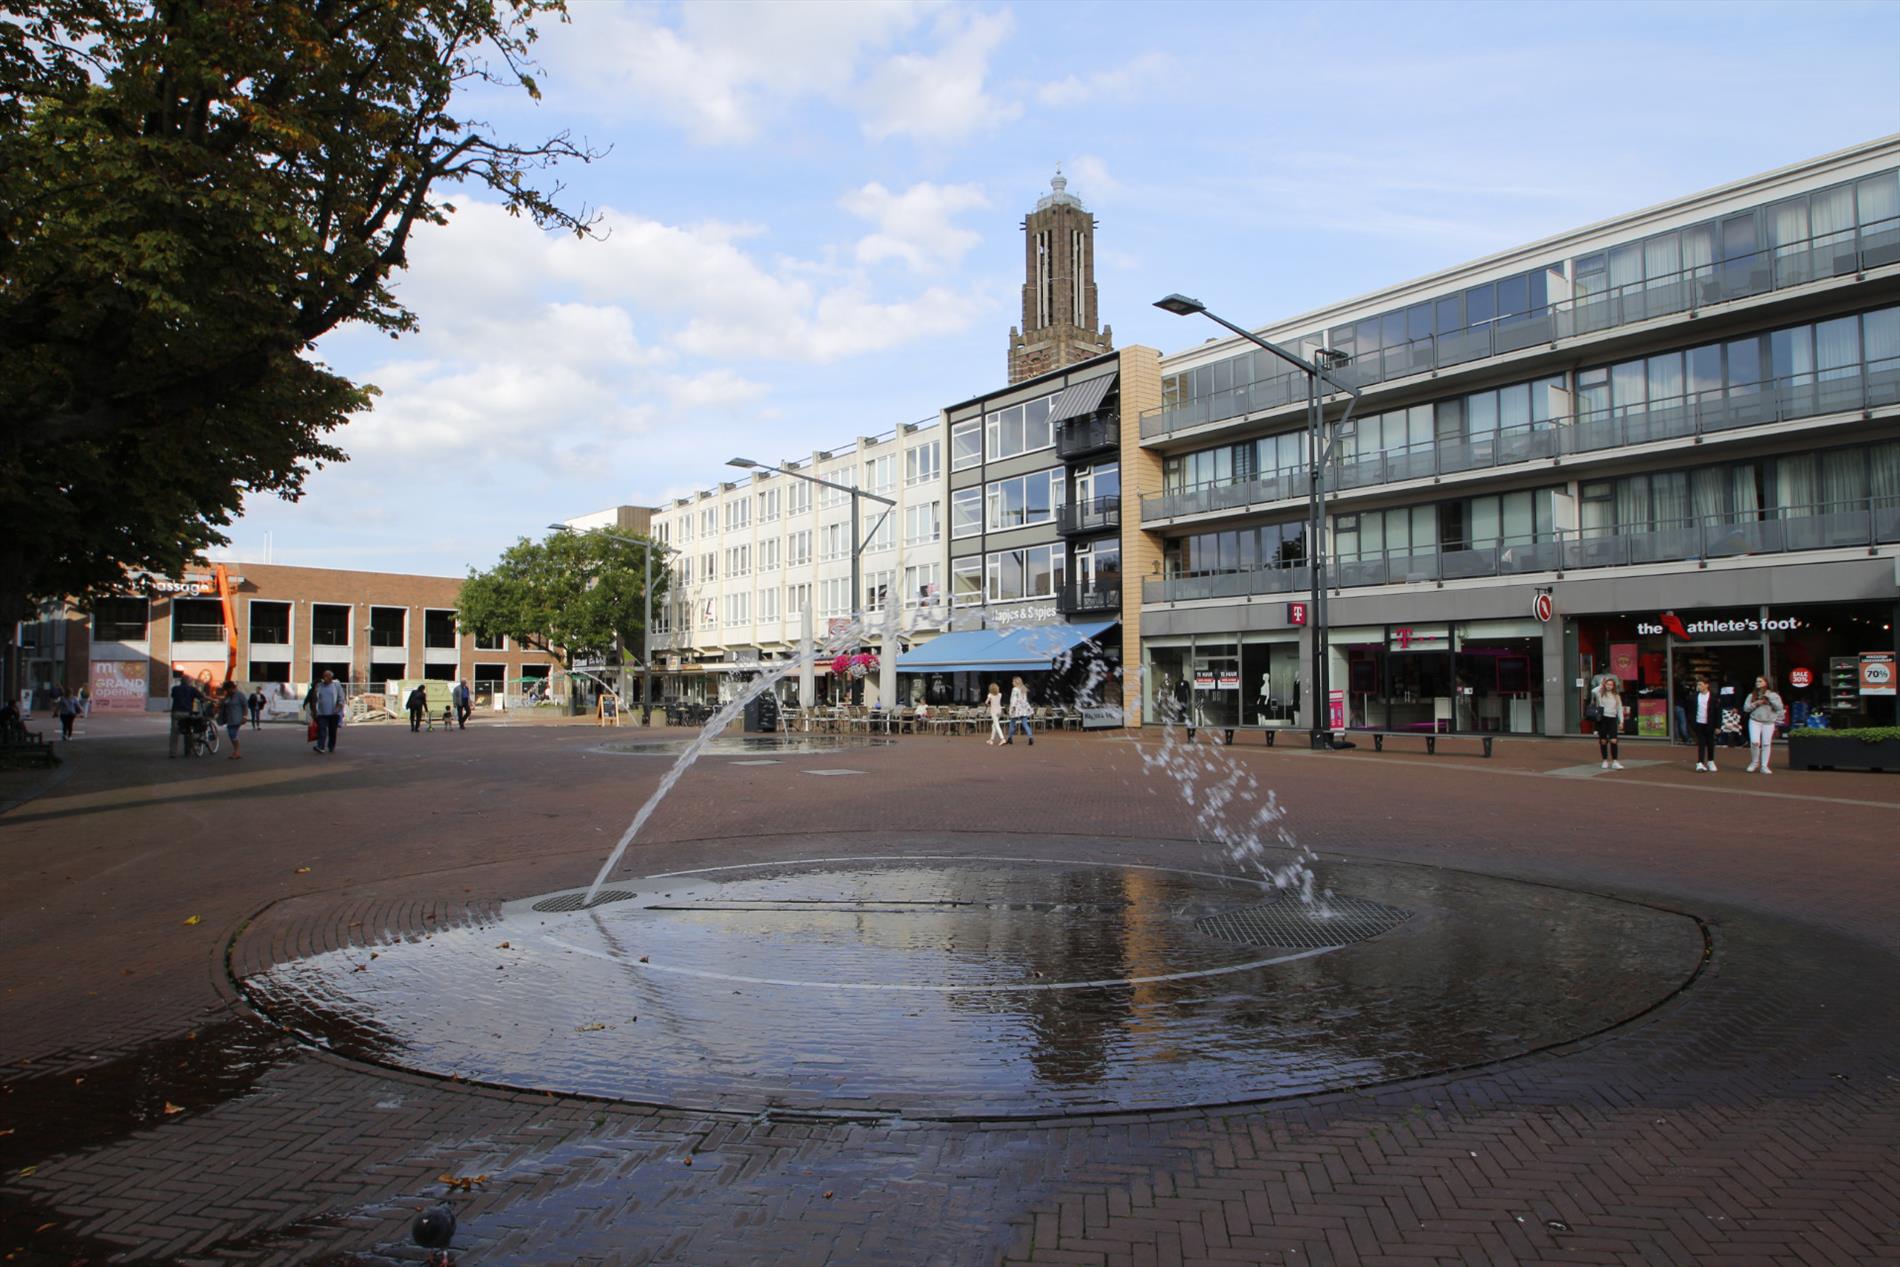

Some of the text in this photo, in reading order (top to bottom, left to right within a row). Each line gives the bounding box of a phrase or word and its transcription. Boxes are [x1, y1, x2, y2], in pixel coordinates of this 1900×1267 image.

[1020, 608, 1027, 619] &
[1293, 606, 1303, 621] T
[1637, 617, 1797, 635] the athlete's foot
[1867, 670, 1888, 678] 70%
[95, 678, 145, 688] GRAND
